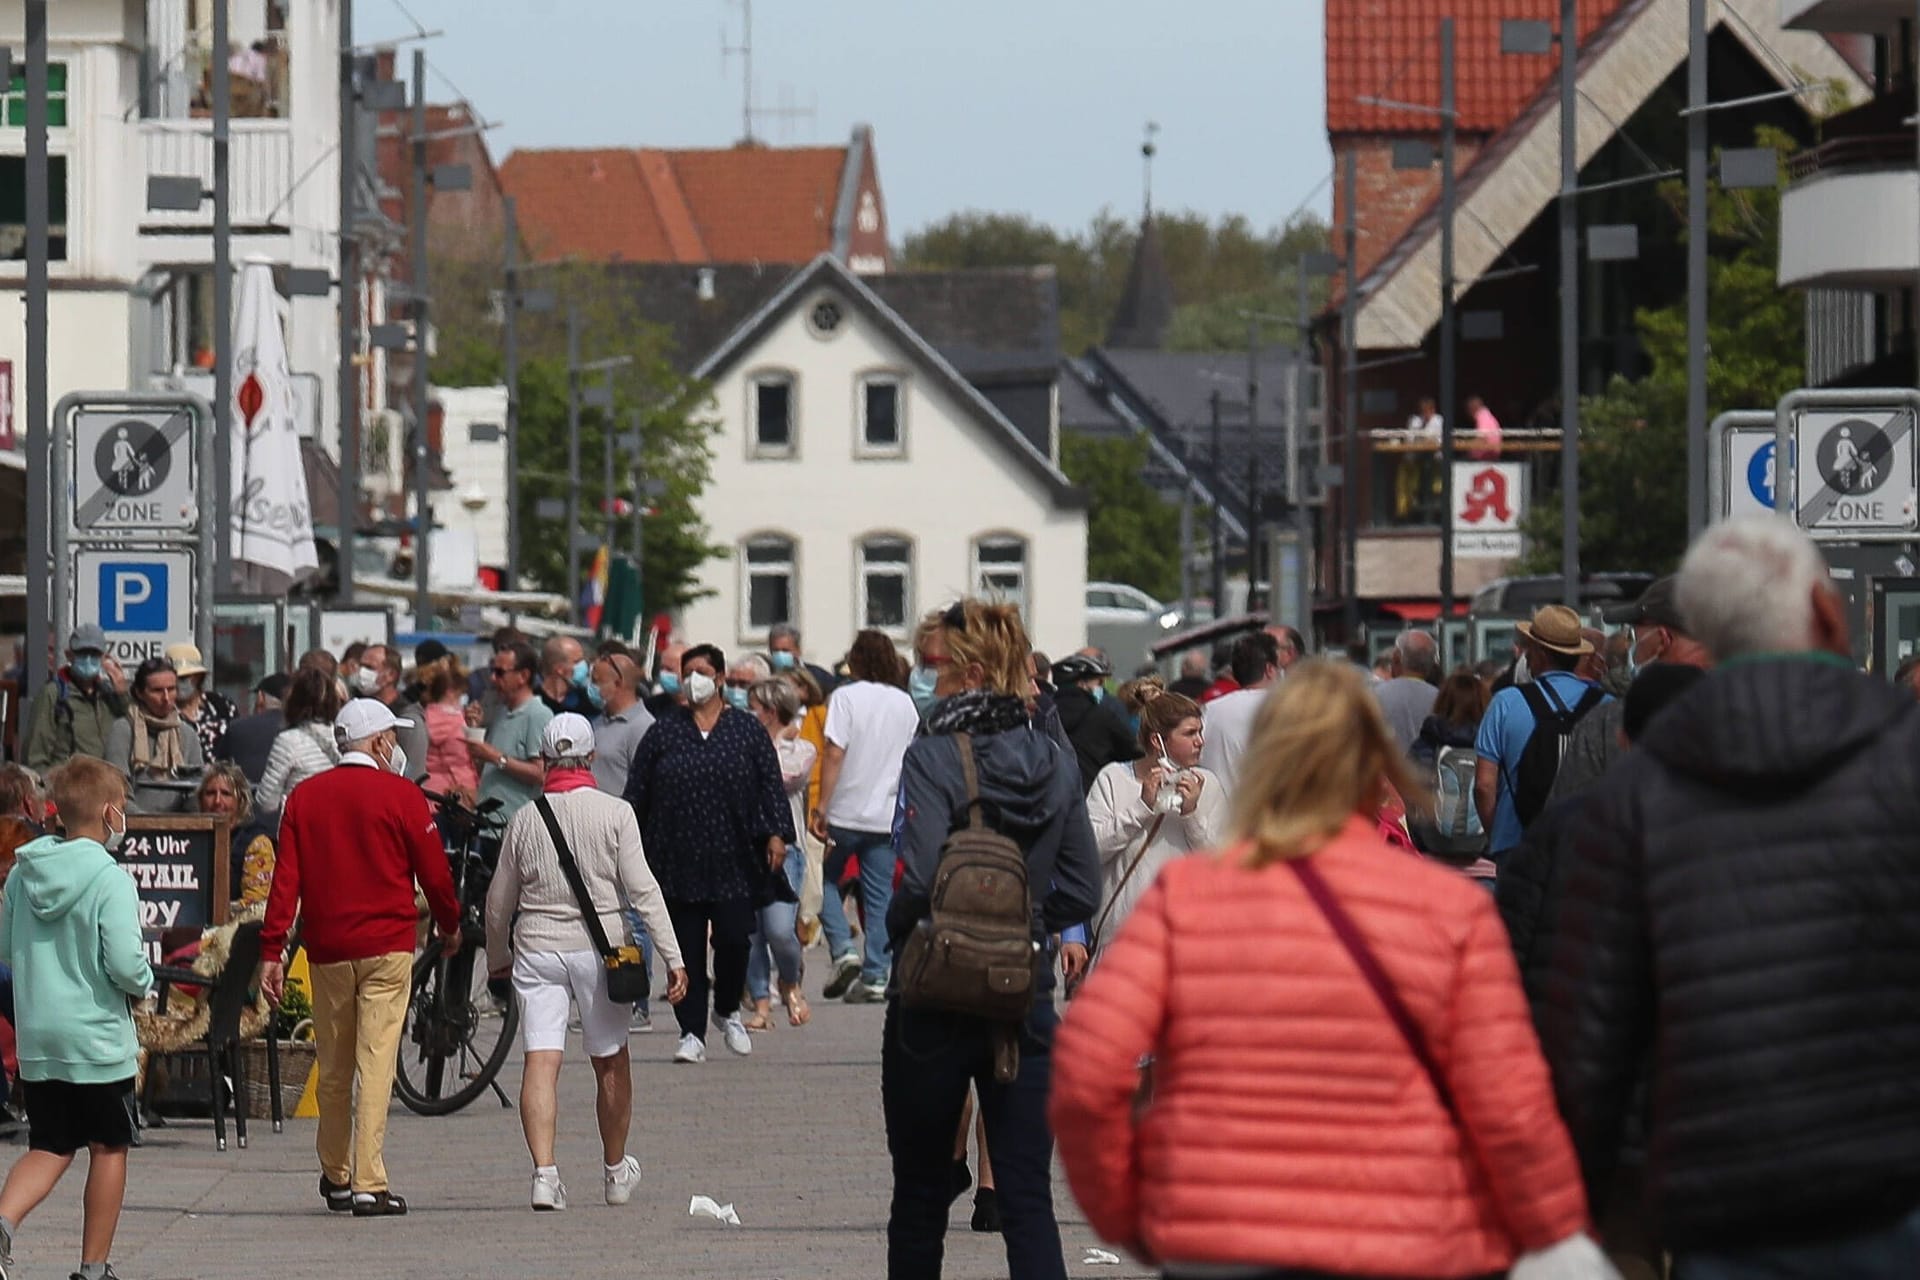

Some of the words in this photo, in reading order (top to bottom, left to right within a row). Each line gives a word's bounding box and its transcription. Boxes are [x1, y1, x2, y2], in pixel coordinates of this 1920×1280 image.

[104, 502, 161, 521] ZONE
[1827, 502, 1884, 520] ZONE
[115, 571, 151, 623] P
[106, 641, 161, 660] ZONE
[124, 837, 151, 856] 24
[156, 835, 190, 855] Uhr
